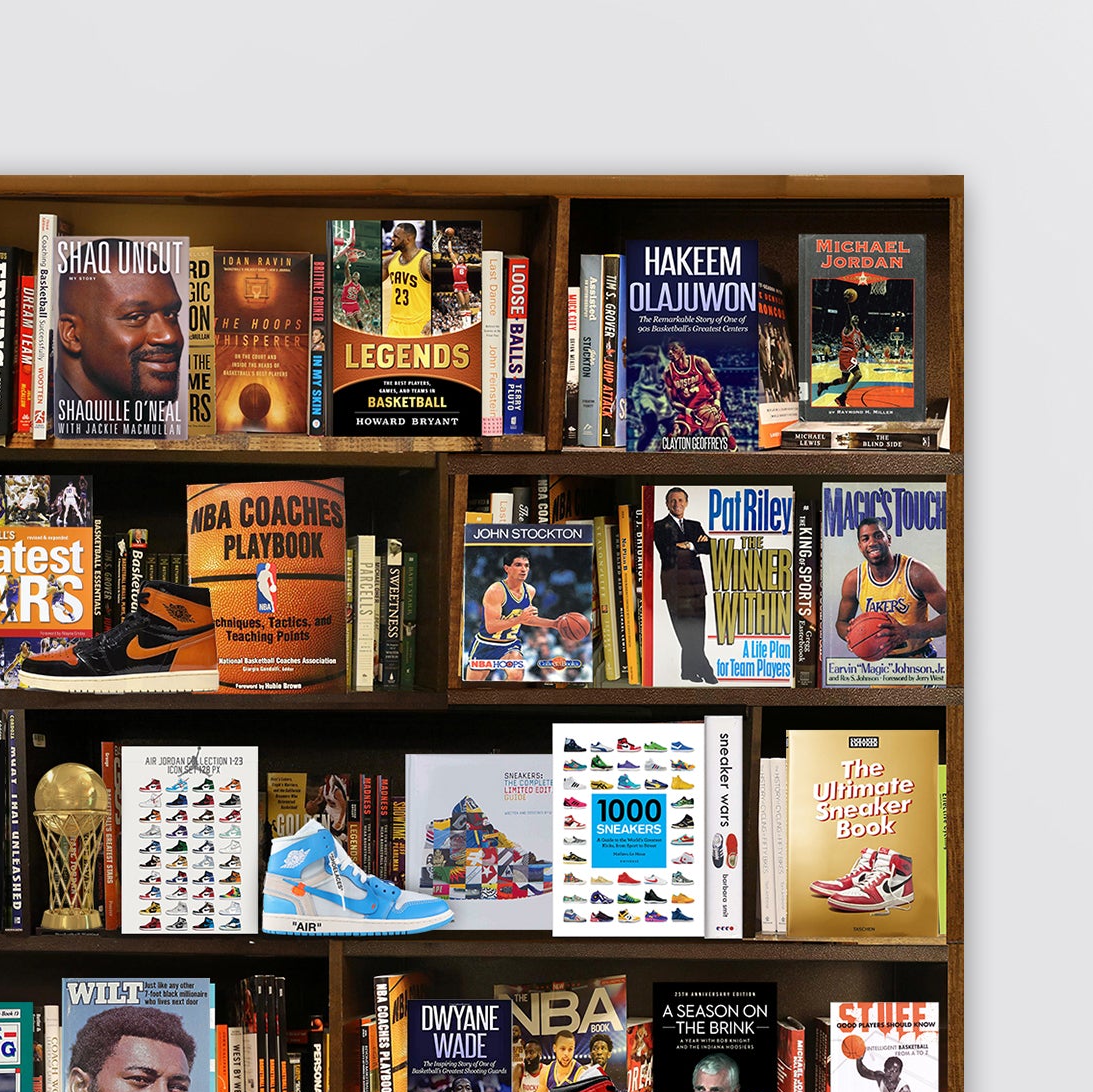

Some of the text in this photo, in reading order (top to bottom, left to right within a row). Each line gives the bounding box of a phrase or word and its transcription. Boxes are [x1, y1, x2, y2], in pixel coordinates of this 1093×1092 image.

[58, 242, 183, 274] SHAQ UNCUT
[816, 239, 909, 253] MICHAEL
[645, 247, 741, 276] HAKEEM
[821, 255, 903, 268] JORDAN
[629, 282, 756, 312] OLAJUWON
[508, 264, 526, 374] LOOSE BALLS
[345, 343, 470, 369] LEGENDS
[58, 400, 130, 422] SHAQUILLE
[368, 397, 446, 408] BASKETBALL
[58, 423, 181, 436] WITH JACKIE MACMULLAN
[356, 418, 458, 426] HOWARD BRYANT
[191, 496, 344, 534] NBA COACHES
[709, 489, 792, 536] Pat Riley
[224, 532, 324, 560] PLAYBOOK
[473, 529, 582, 539] JOHN STOCKTON
[740, 536, 764, 549] THE
[710, 539, 791, 592] WINNER
[799, 528, 811, 616] KING SPORTS
[715, 593, 791, 645] WITHIN
[720, 733, 732, 827] sneaker wars
[841, 759, 884, 778] The
[812, 778, 915, 802] Ultimate
[596, 800, 662, 822] 1000
[816, 797, 912, 822] Sneaker
[596, 824, 662, 834] SNEAKERS
[836, 816, 896, 839] Book
[67, 981, 144, 1005] WILT
[144, 981, 156, 989] Just
[169, 982, 178, 990] any
[180, 981, 194, 989] other
[163, 990, 178, 998] black
[180, 990, 208, 998] millionaire
[422, 1005, 499, 1031] DWYANE
[663, 1005, 767, 1018] A SEASON ON
[676, 1021, 755, 1034] THE BRINK
[433, 1032, 487, 1058] WADE
